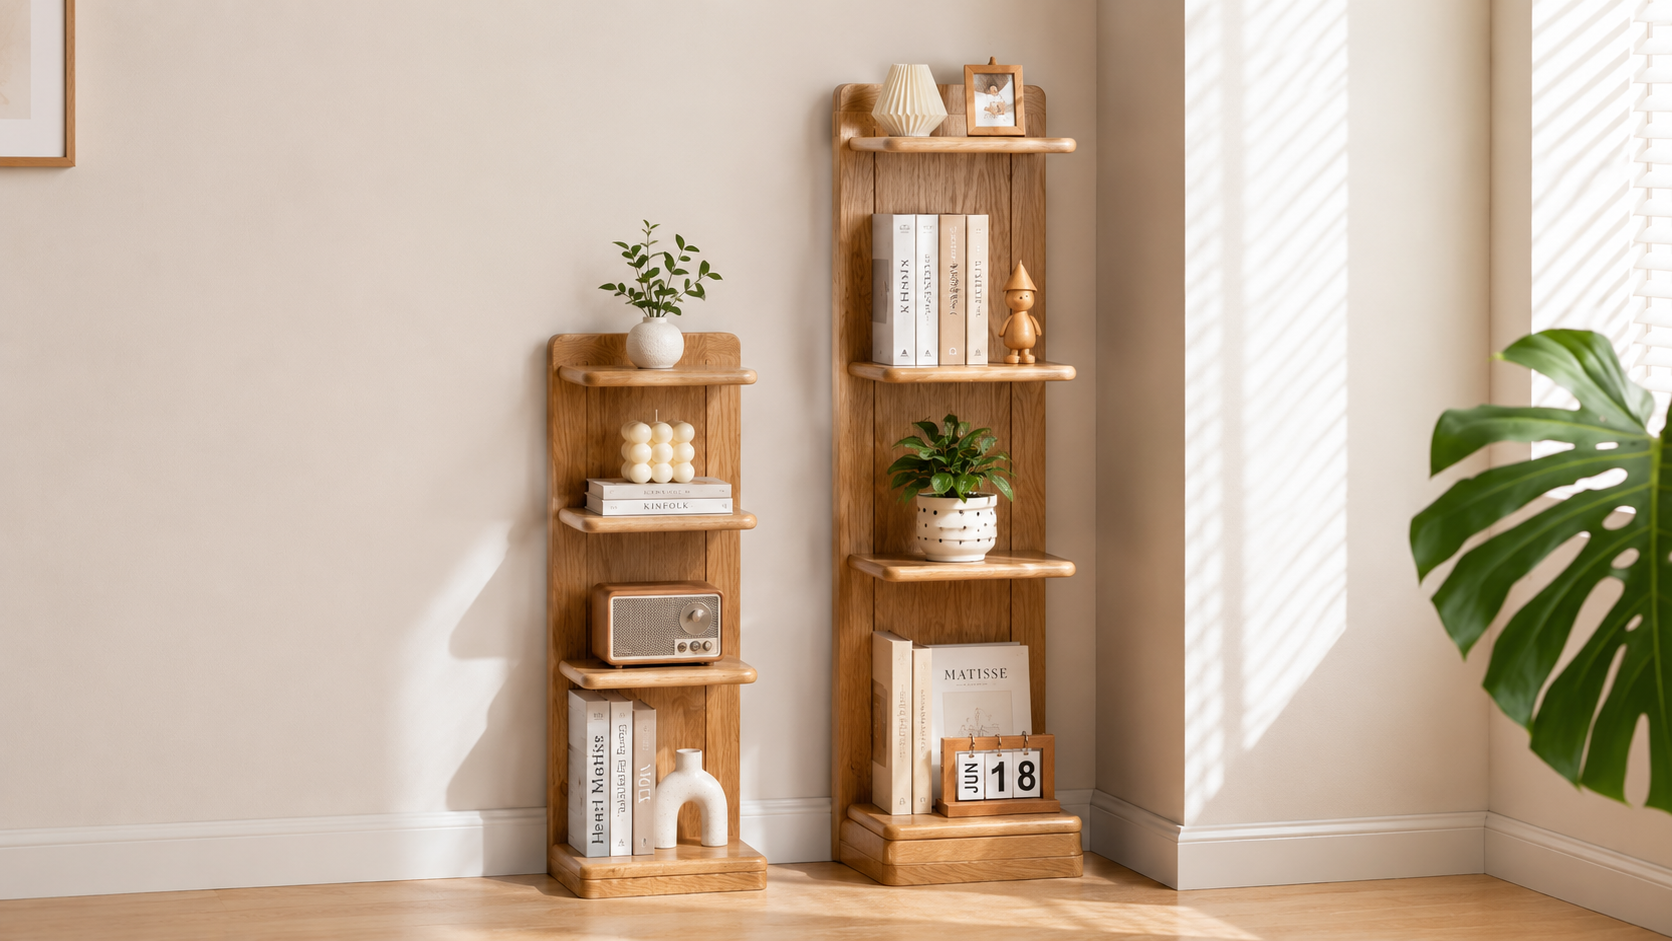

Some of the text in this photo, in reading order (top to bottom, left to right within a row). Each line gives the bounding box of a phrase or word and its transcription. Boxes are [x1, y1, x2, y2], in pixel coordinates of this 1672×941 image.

[643, 501, 689, 510] KINFOLK
[944, 667, 1008, 681] MATISSE
[964, 762, 979, 794] JUN
